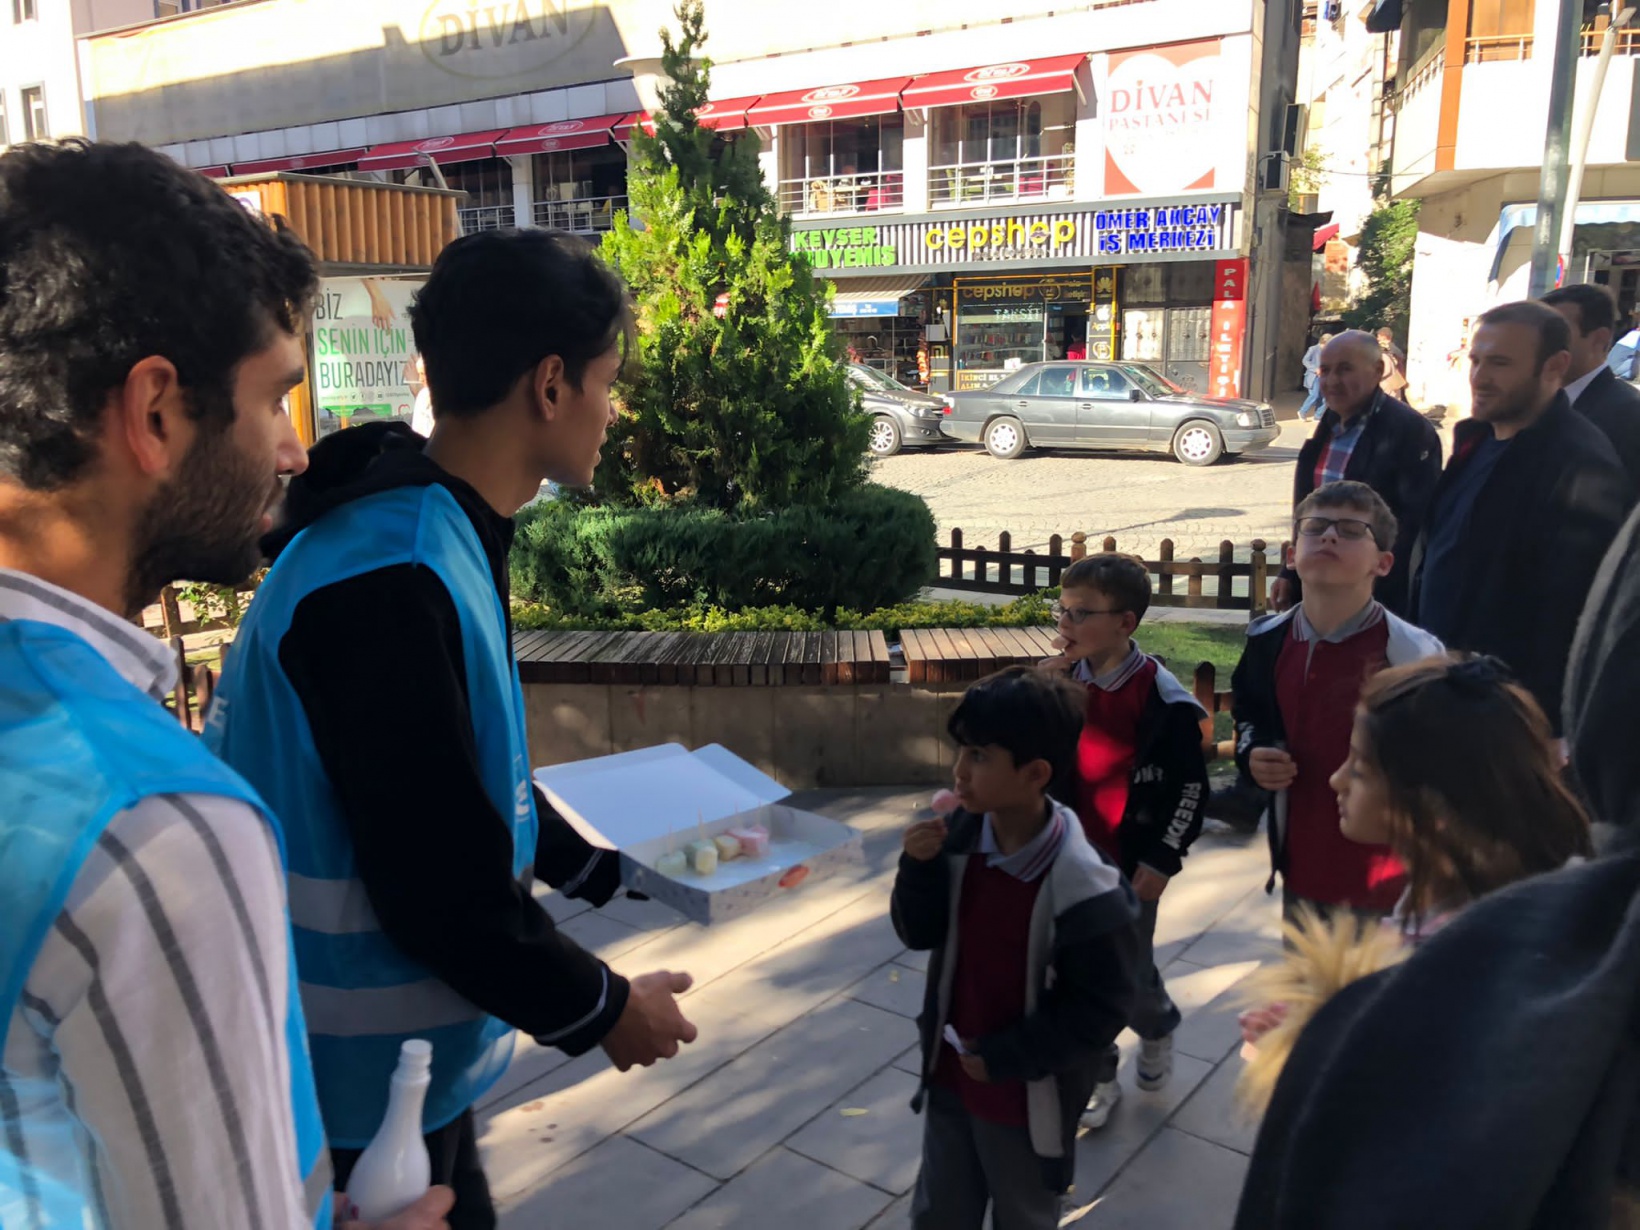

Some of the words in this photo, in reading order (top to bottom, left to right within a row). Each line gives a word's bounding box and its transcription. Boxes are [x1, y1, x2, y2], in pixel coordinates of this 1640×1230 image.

[1110, 79, 1213, 113] DİVAN
[925, 217, 1076, 253] cepshop
[1095, 209, 1149, 230] ÖMER
[1156, 206, 1220, 227] AKÇAY
[1099, 233, 1120, 252] İŞ
[1128, 229, 1213, 250] MERKEZİ
[1221, 268, 1237, 310] PALA
[1161, 782, 1202, 850] FREEDOM
